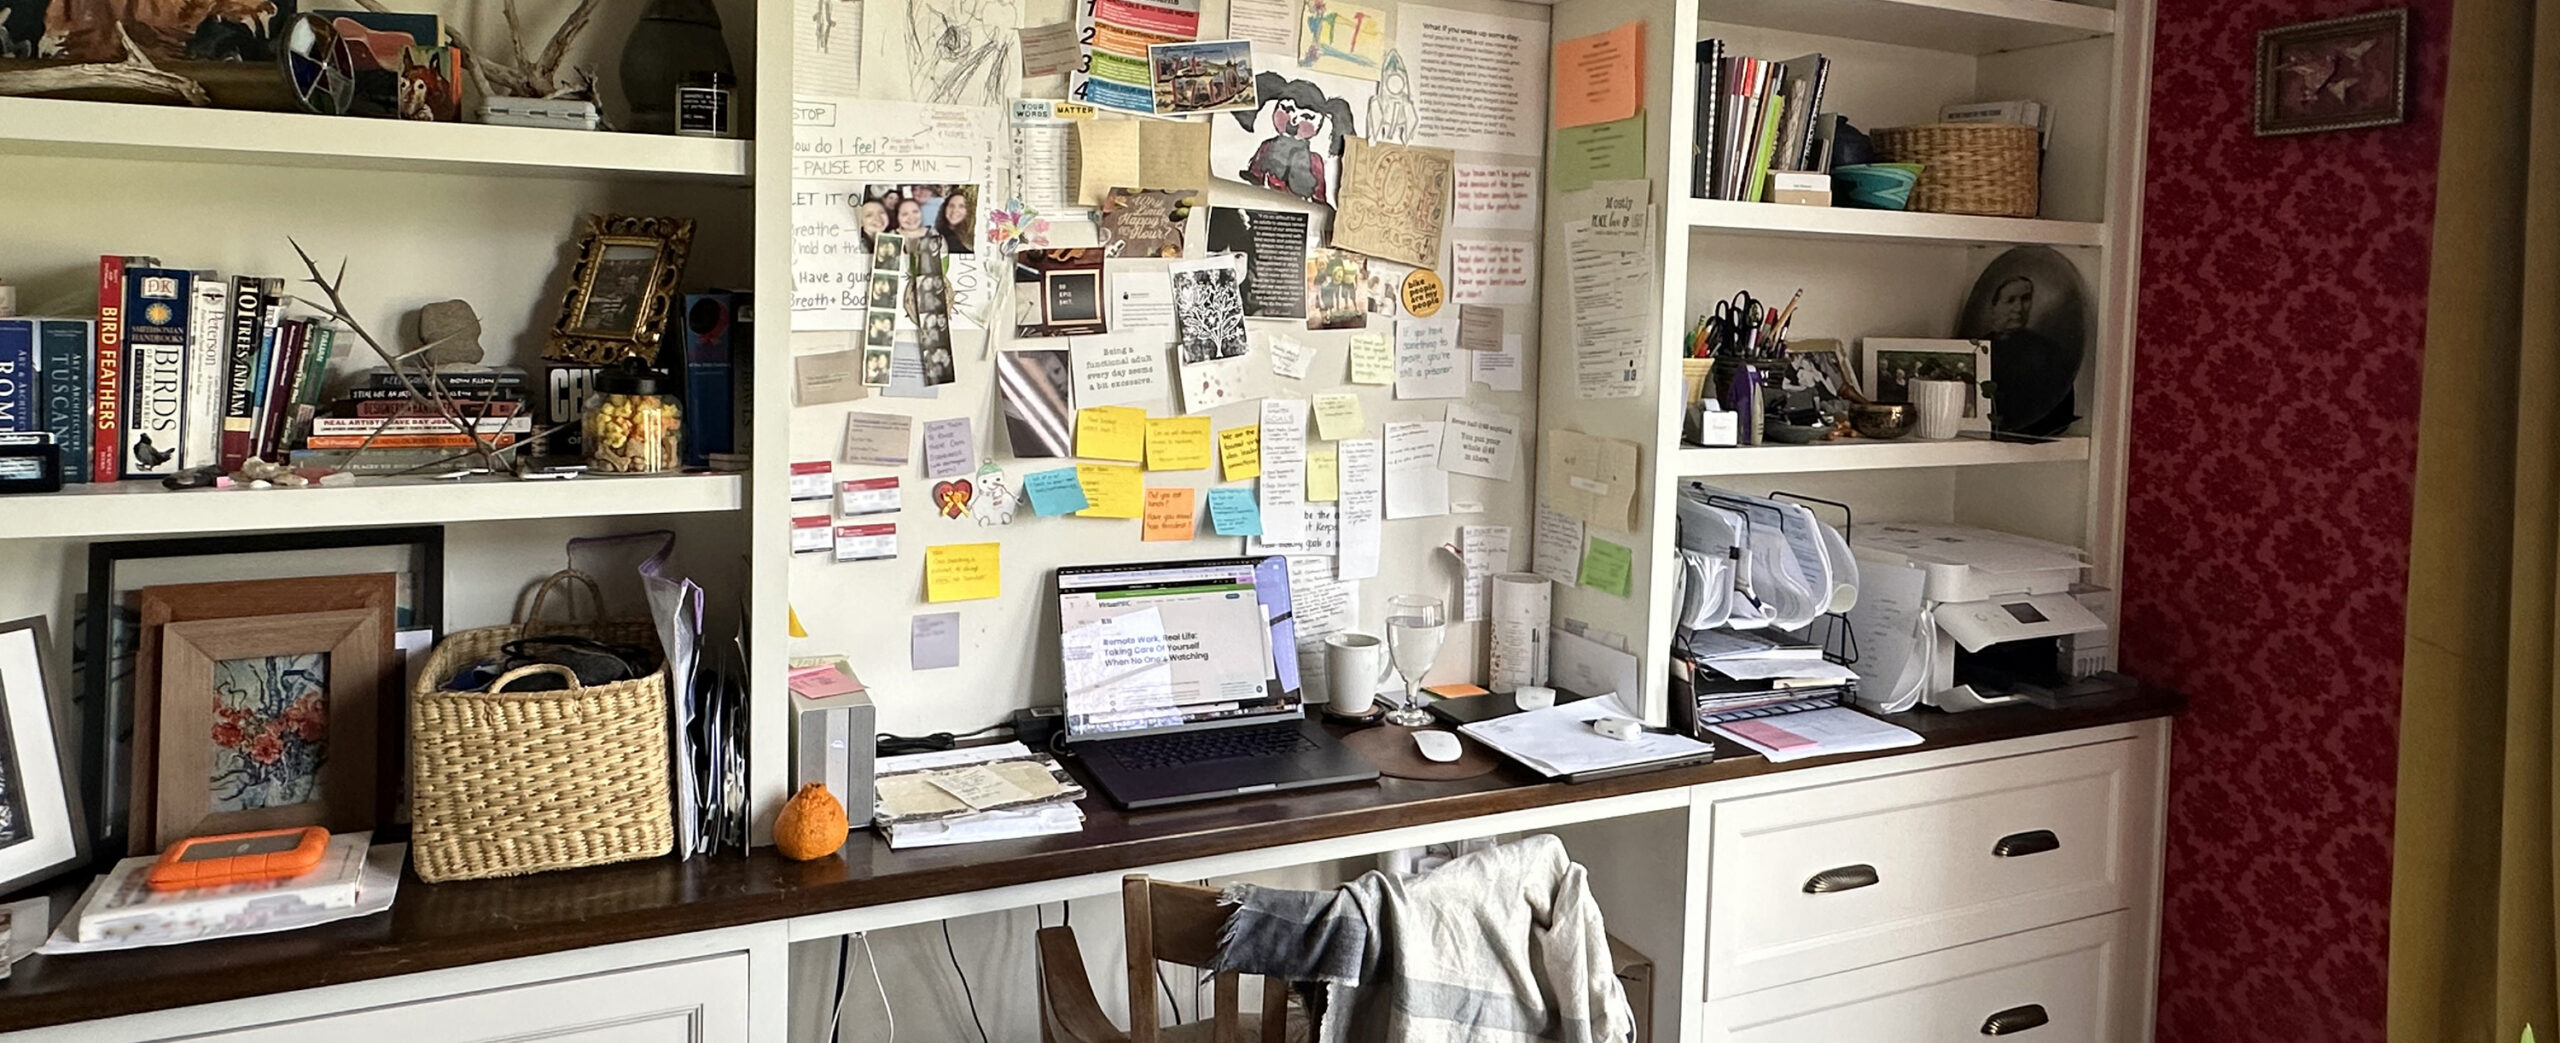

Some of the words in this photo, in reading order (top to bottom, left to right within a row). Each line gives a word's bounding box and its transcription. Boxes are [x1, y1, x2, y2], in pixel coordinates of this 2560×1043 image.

[1080, 27, 1097, 45] 2
[1077, 54, 1093, 74] 3
[1074, 81, 1089, 101] 4
[792, 108, 826, 121] STOP
[1017, 109, 1048, 118] WORDS
[1021, 103, 1045, 111] YOUR
[1057, 106, 1095, 115] MATTER
[793, 142, 810, 153] ow
[815, 136, 832, 154] do
[852, 136, 877, 155] feel
[803, 160, 853, 176] PAUSE
[859, 159, 886, 174] FOR
[893, 158, 904, 173] 5
[825, 193, 843, 206] IT
[847, 192, 864, 208] OU
[1117, 212, 1161, 230] Happy
[1129, 226, 1173, 240] Hour?
[823, 243, 838, 255] on
[799, 271, 831, 284] Have
[835, 272, 843, 283] a
[1407, 278, 1425, 289] bike
[147, 279, 173, 294] DK
[1409, 283, 1437, 298] people
[237, 285, 259, 318] 101
[841, 290, 868, 307] Bod
[1410, 294, 1424, 304] are
[1424, 289, 1438, 299] my
[1412, 297, 1440, 313] people
[265, 306, 276, 327] TOP
[101, 307, 119, 345] BIRD
[131, 325, 185, 335] SMITHSONIAN
[131, 333, 185, 344] HANDBOOKS
[205, 310, 225, 366] Peterson
[236, 318, 252, 359] TREES
[1402, 339, 1437, 352] something
[315, 330, 330, 363] ITALIAN
[1103, 347, 1128, 356] Being
[17, 350, 28, 363] ART
[72, 353, 82, 366] ART
[1086, 356, 1129, 369] functional
[1130, 354, 1153, 364] adult
[144, 360, 152, 393] NORTH
[1087, 371, 1110, 380] every
[1111, 368, 1127, 378] day
[1128, 366, 1154, 375] seems
[98, 350, 118, 431] FEATHERS
[152, 349, 180, 432] BIRDS
[230, 363, 250, 417] INDIANA
[18, 383, 28, 432] ARCHITECT
[51, 354, 70, 454] TUSCANY
[143, 394, 151, 430] AMERICA
[72, 384, 82, 451] ARCHITECTURE
[1304, 509, 1313, 520] be
[1317, 510, 1330, 519] the
[1103, 635, 1136, 646] Remote
[1137, 634, 1160, 644] Work,
[1162, 633, 1181, 642] Real
[1181, 631, 1198, 640] Life:
[1104, 646, 1133, 657] Taking
[1134, 645, 1155, 654] Care
[1155, 644, 1165, 653] Of
[1166, 641, 1200, 652] Yourself
[1104, 657, 1130, 667] When
[1130, 656, 1143, 665] No
[1168, 651, 1209, 661] Watching
